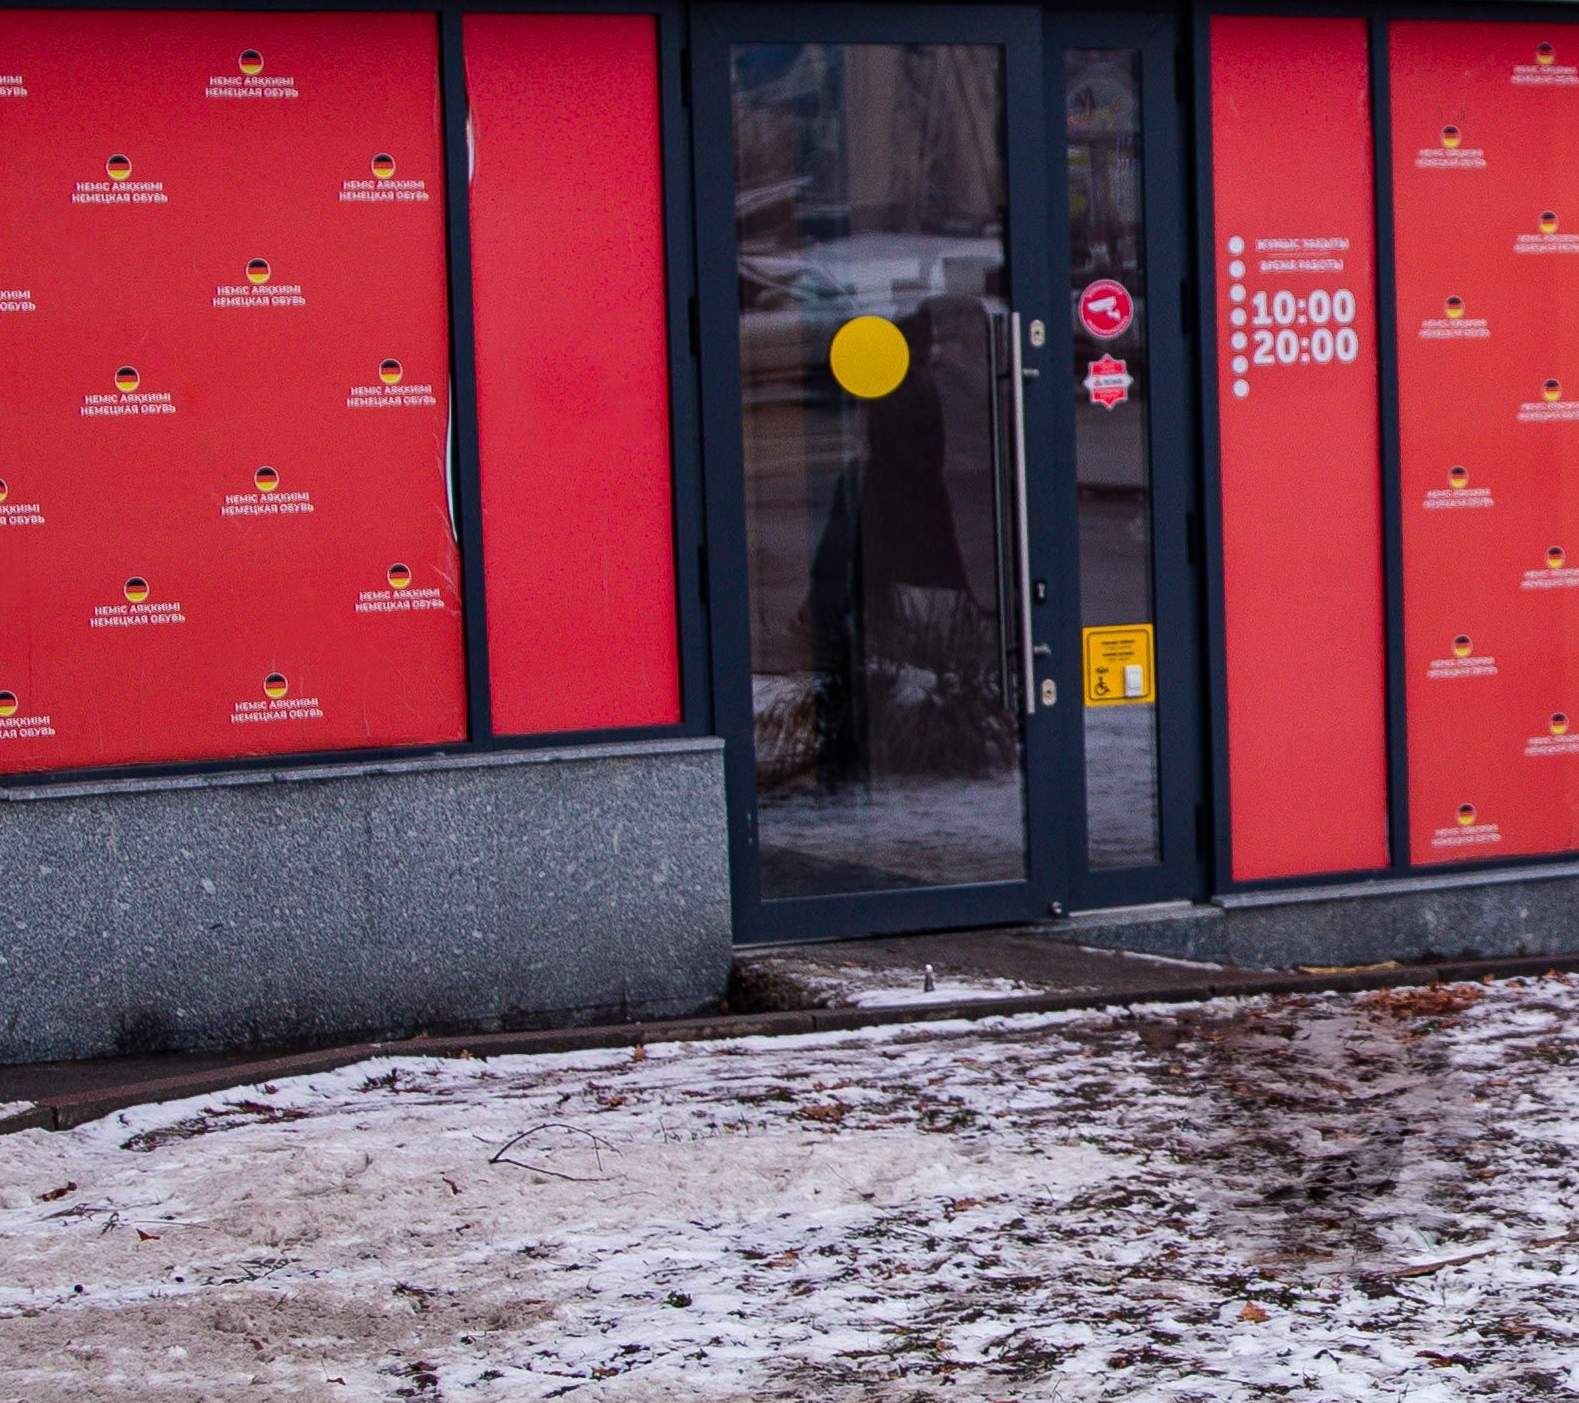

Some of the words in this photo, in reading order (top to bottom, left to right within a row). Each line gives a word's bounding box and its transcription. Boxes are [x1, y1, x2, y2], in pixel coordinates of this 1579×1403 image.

[0, 300, 37, 312] ОБУВЬ
[1251, 289, 1356, 326] 10:00
[1252, 327, 1359, 365] 20:00
[8, 513, 46, 525] ОБУВЬ
[19, 725, 56, 737] ОБУВЬ
